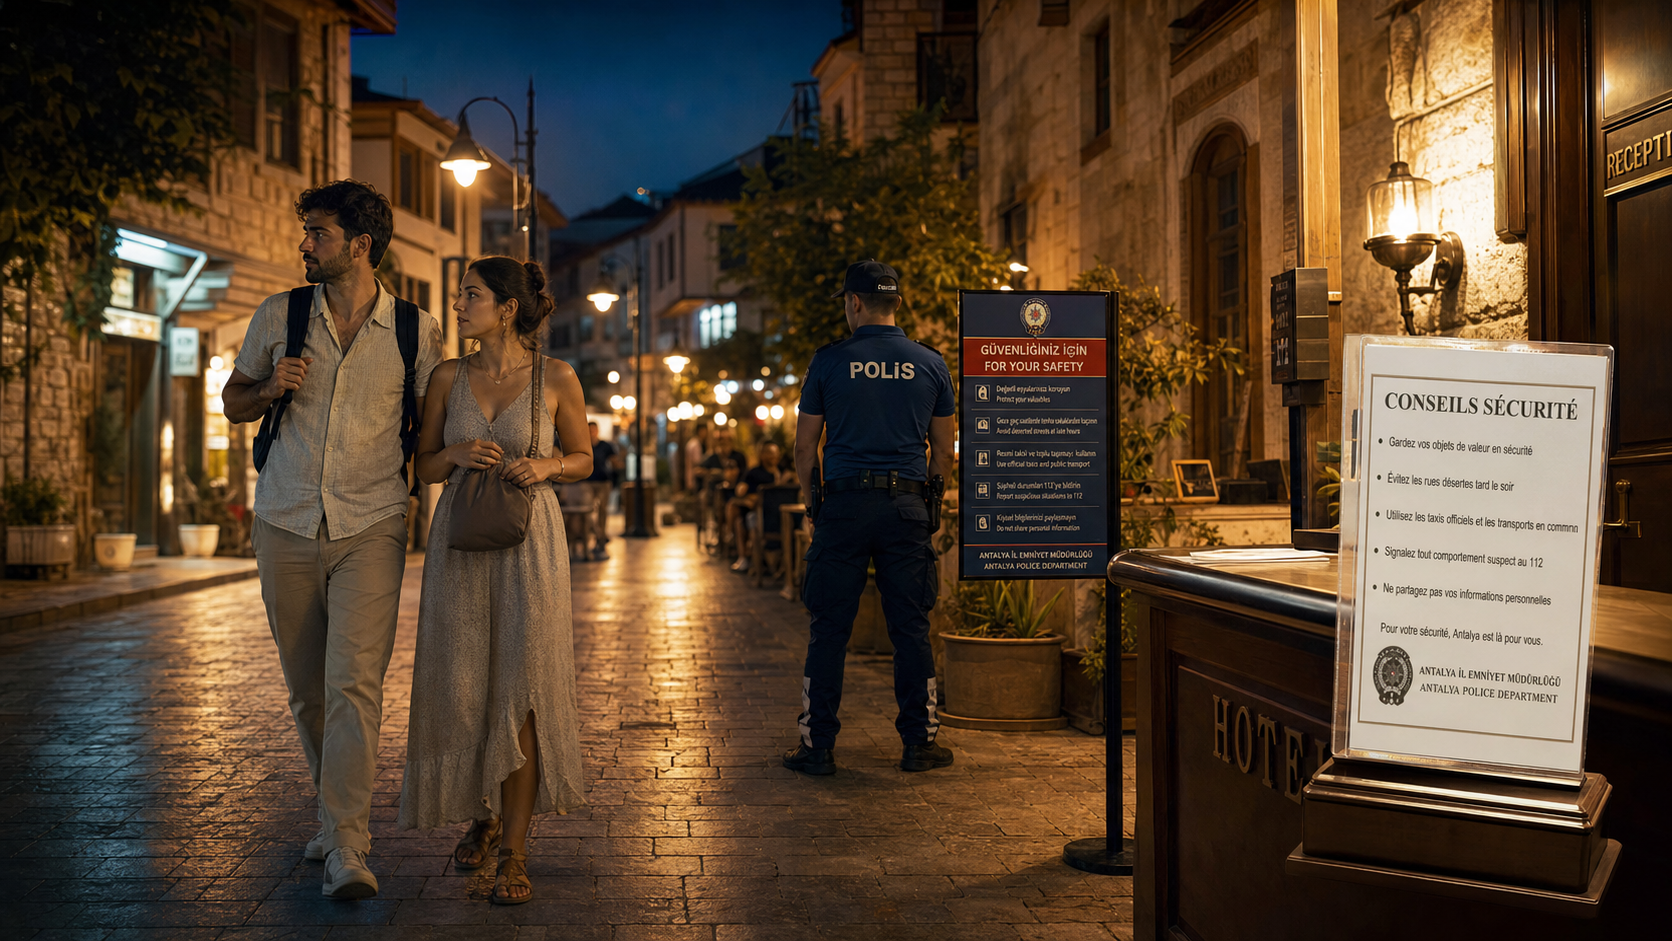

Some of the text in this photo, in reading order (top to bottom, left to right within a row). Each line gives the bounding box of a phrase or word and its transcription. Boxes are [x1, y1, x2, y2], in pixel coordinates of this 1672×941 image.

[1606, 130, 1672, 179] RECEPTI
[985, 361, 1084, 372] FOR YOUR SAFETY
[1384, 392, 1578, 421] CONSEILS SÉCURITÉ
[1389, 436, 1533, 456] Gardez vos objets de valeur en sécurité
[1387, 471, 1514, 492] Évitez les rues désertes tard le soir
[1386, 509, 1413, 522] Utilisez
[1414, 511, 1426, 523] les
[1427, 512, 1445, 524] taxis
[1446, 514, 1474, 527] officiels
[1475, 515, 1483, 527] et
[1484, 516, 1496, 528] les
[1497, 517, 1534, 531] transports
[1535, 521, 1546, 531] en
[984, 562, 1015, 570] ANTALYA
[1016, 562, 1041, 570] POLICE
[1384, 546, 1543, 568] Signalez tout comportement suspect au 112
[1383, 582, 1551, 606] Ne partagez pas vos informations personnelles
[1380, 622, 1544, 646] Pour votre sécurité, Antalya est là pour vous.
[1419, 666, 1456, 679] ANTALYA
[1458, 666, 1467, 679] İL
[1468, 668, 1505, 683] EMNİYET
[1420, 683, 1558, 704] ANTALYA POLICE DEPARTMENT
